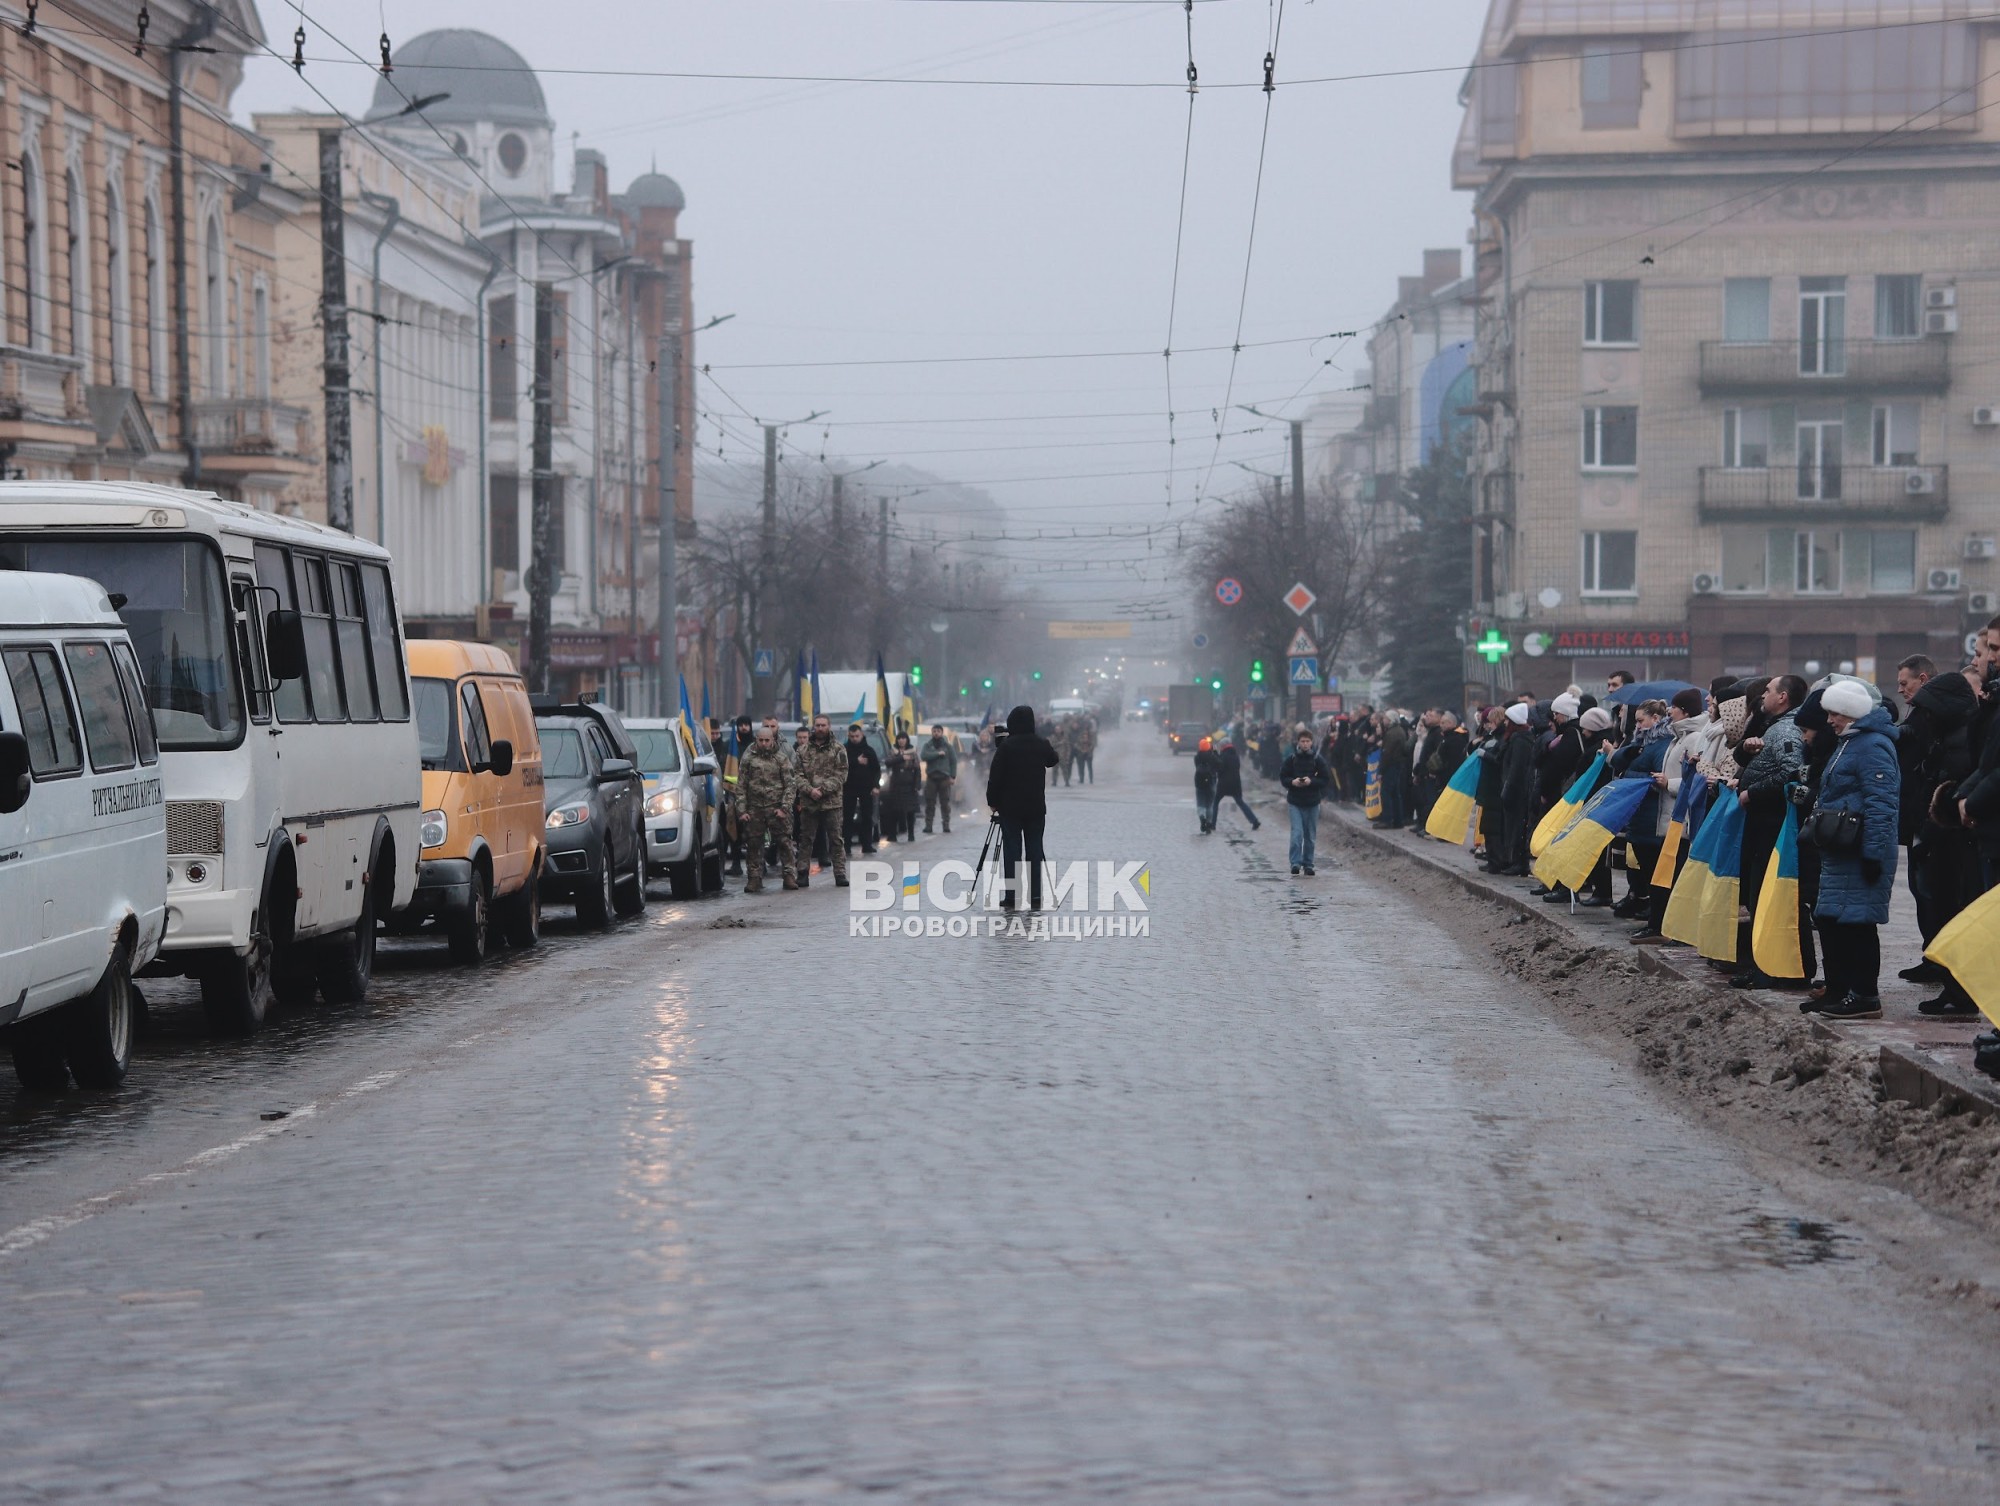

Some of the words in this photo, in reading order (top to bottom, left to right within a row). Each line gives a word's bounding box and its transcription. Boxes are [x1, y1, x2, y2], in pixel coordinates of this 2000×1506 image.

[1557, 631, 1645, 647] АПТЕКА
[1557, 647, 1596, 656] ГОЛОВНА
[1598, 647, 1631, 656] АПТЕКА
[1633, 647, 1660, 656] ТВОГО
[1663, 647, 1689, 656] МІСТА
[92, 777, 141, 817] РИТУАЛЬНИЙ
